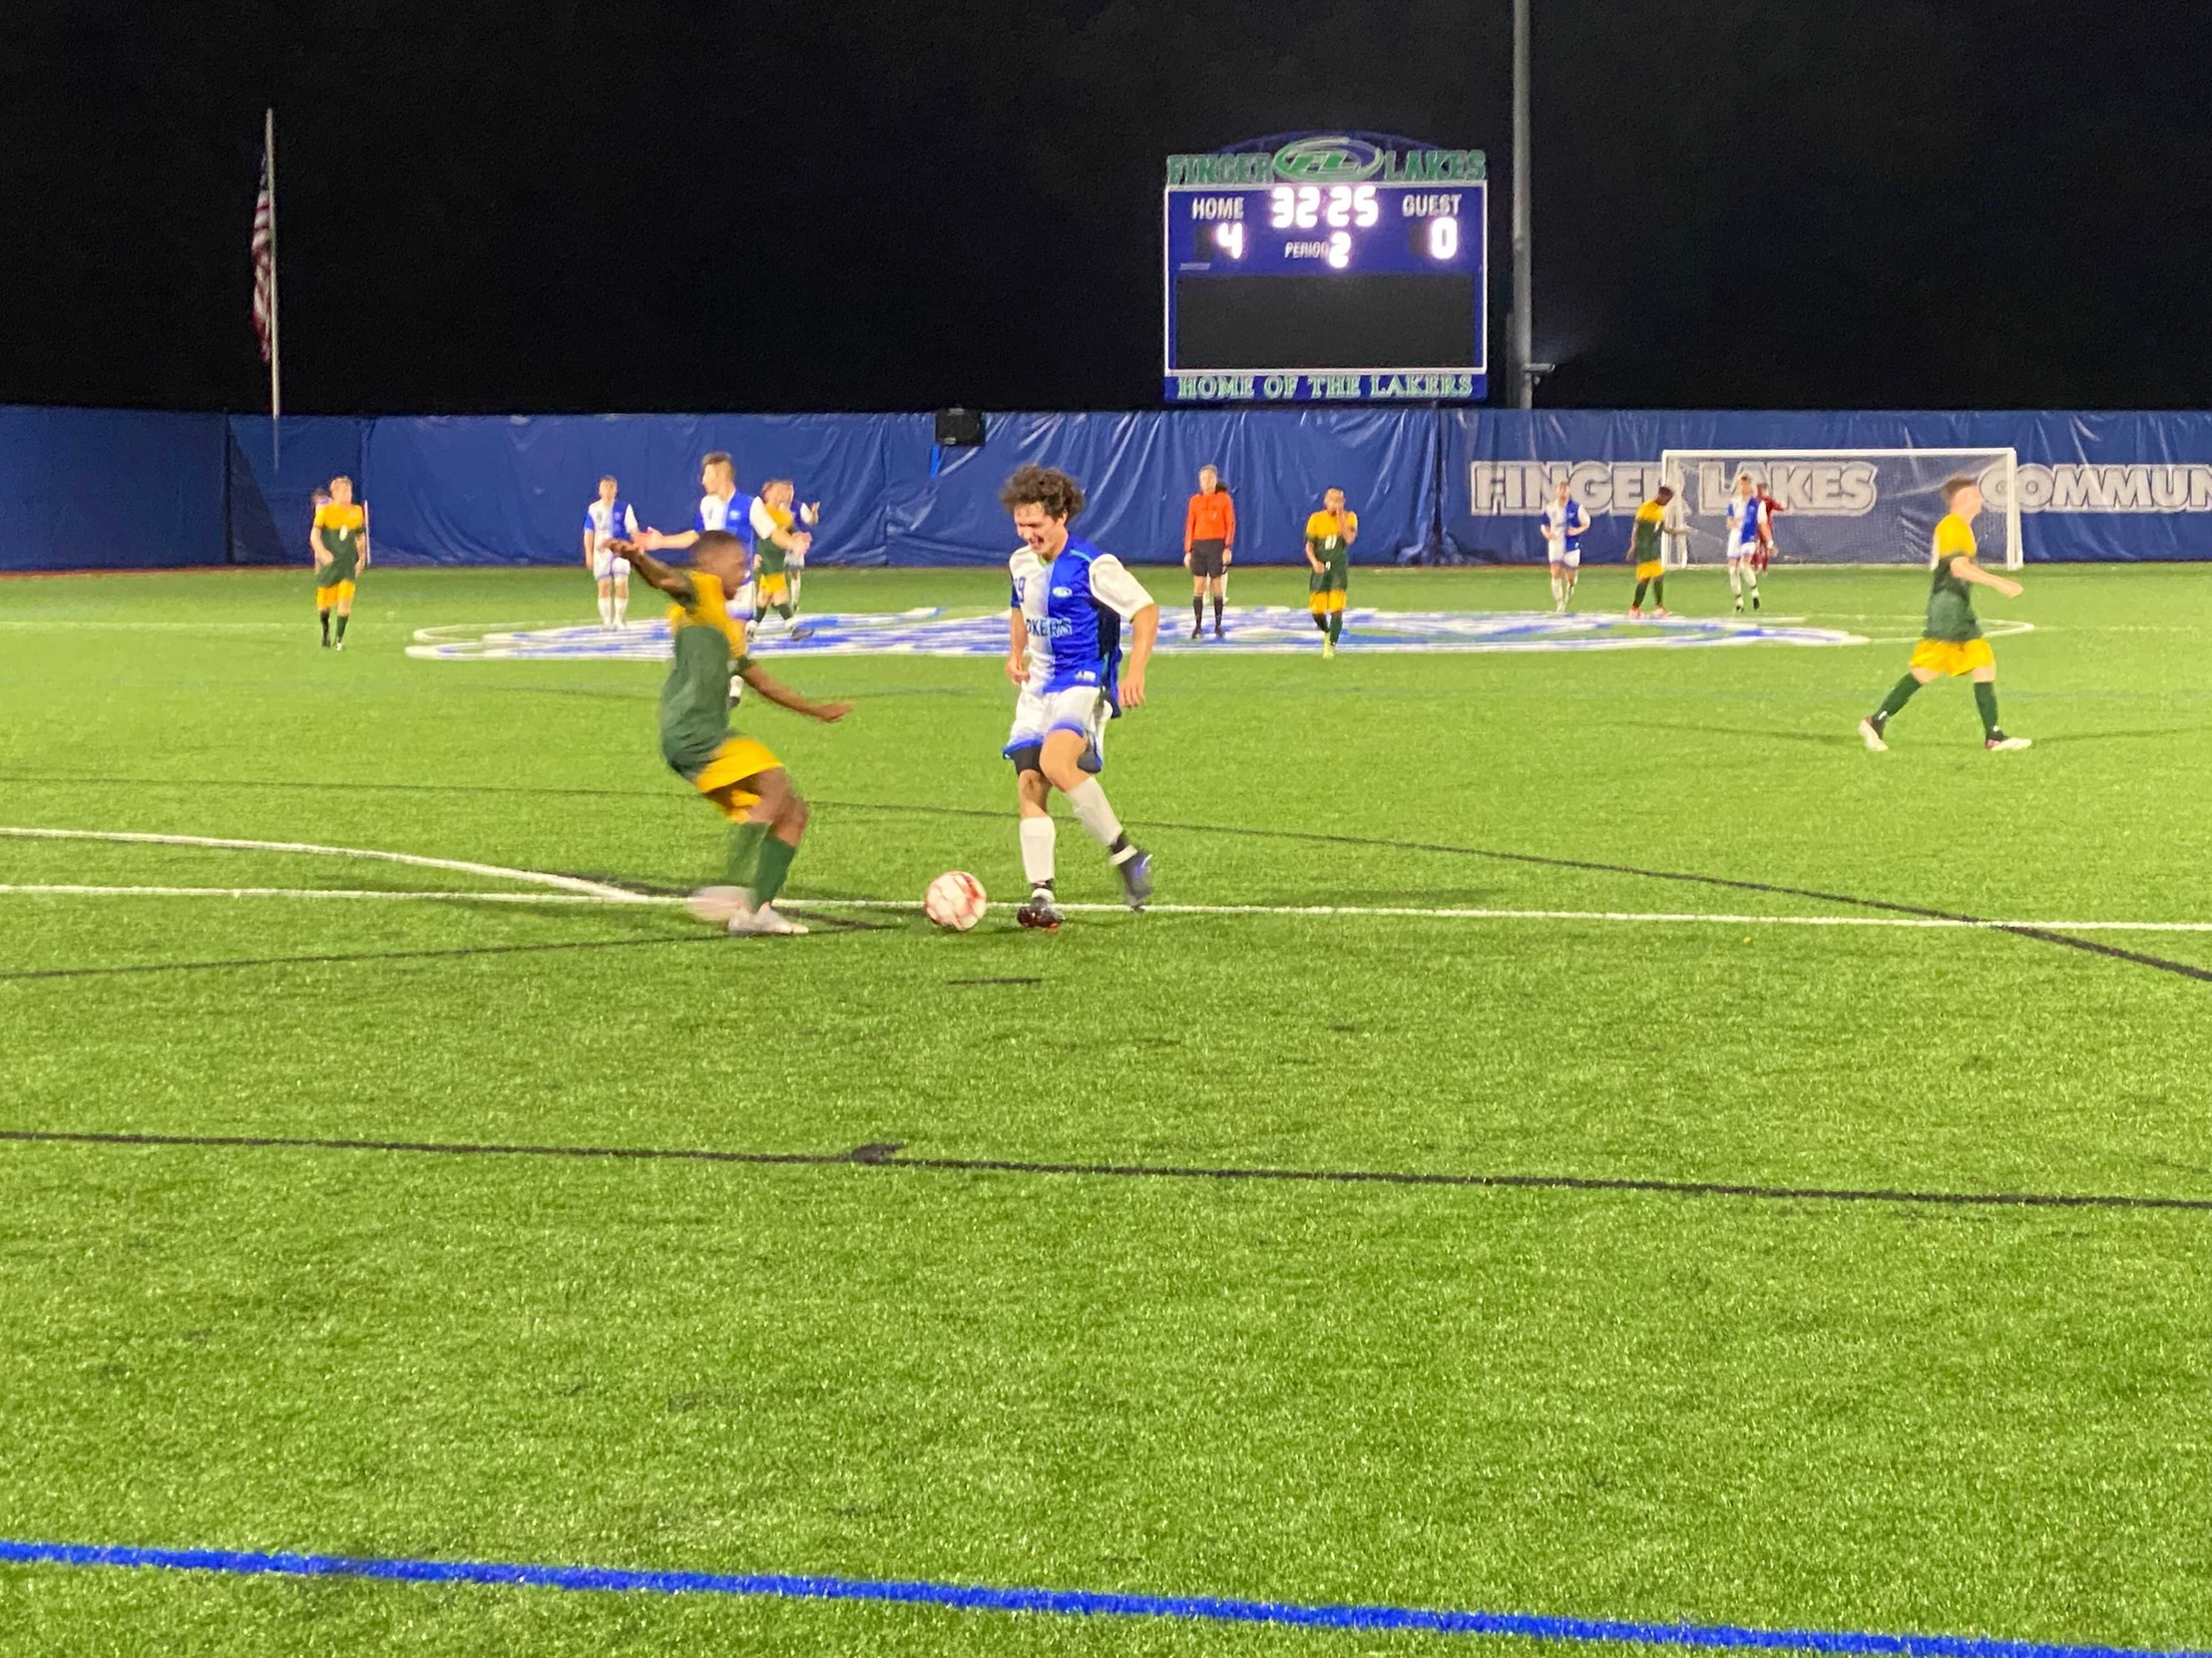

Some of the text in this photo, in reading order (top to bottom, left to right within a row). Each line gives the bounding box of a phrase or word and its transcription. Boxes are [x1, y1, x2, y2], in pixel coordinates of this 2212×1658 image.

[1166, 150, 1487, 184] FINGER LAKES
[1192, 198, 1245, 220] HOME
[1402, 194, 1462, 216] GUEST
[1216, 222, 1242, 258] 4
[1328, 231, 1352, 268] 2
[1429, 216, 1459, 259] 0
[1177, 374, 1474, 399] HOME OF THE LAKERS
